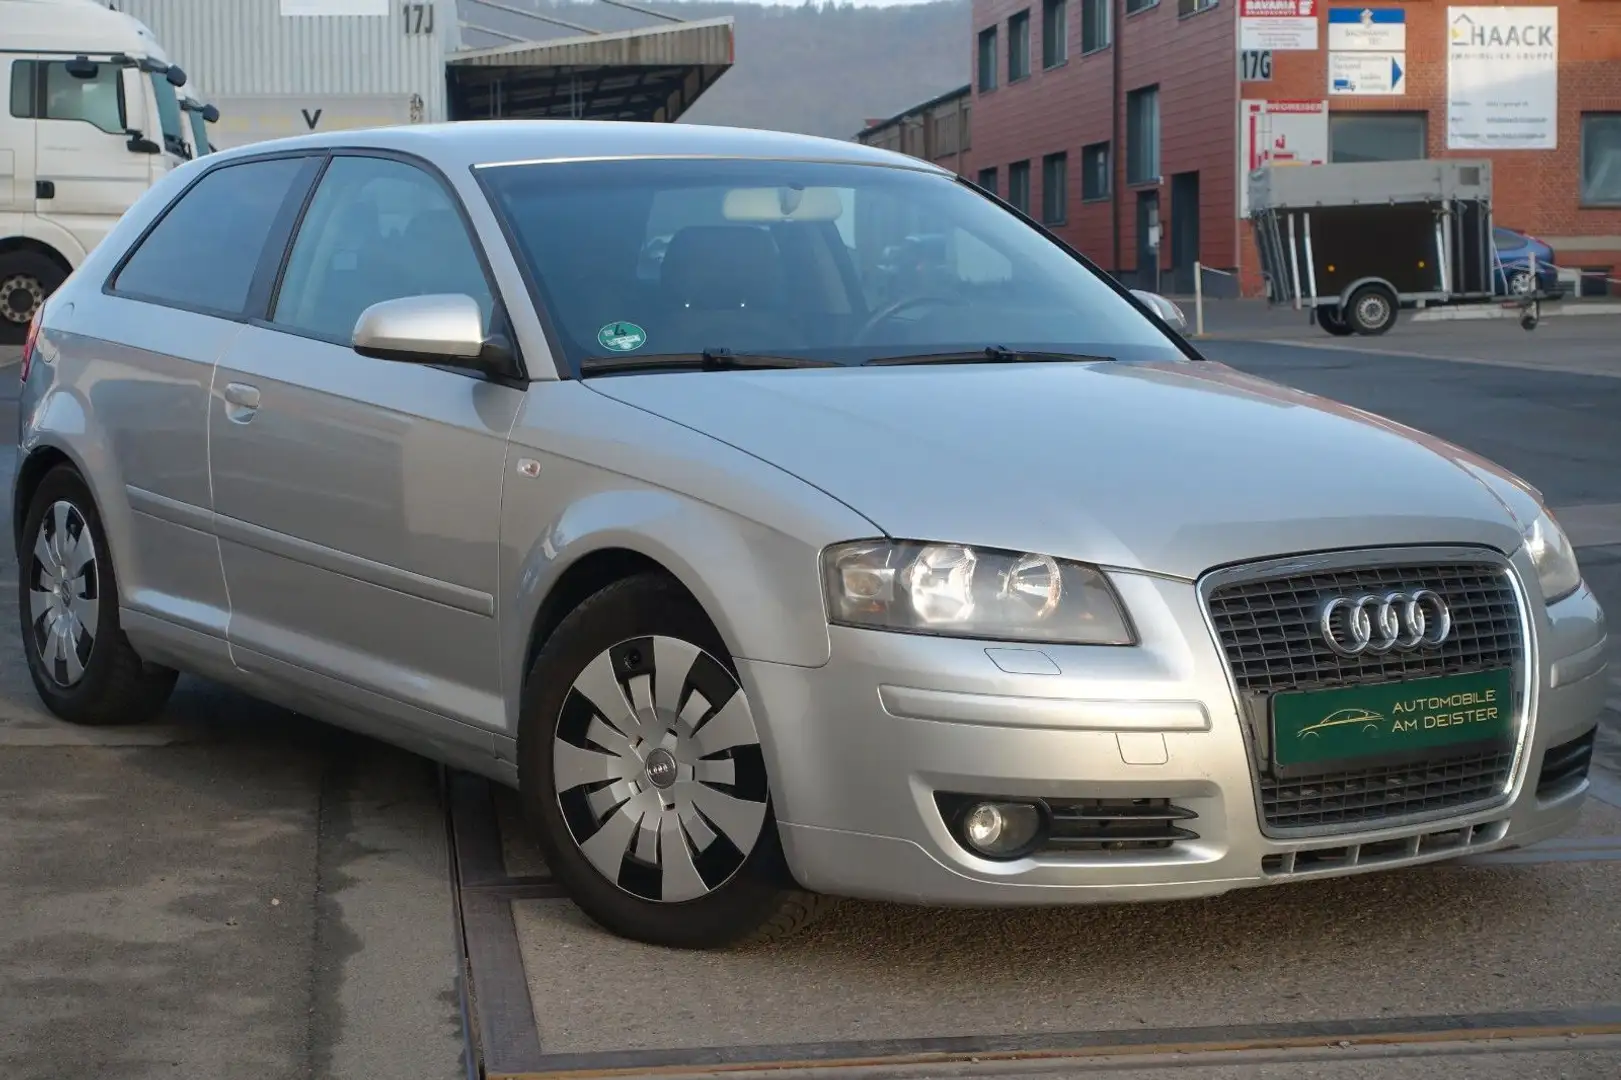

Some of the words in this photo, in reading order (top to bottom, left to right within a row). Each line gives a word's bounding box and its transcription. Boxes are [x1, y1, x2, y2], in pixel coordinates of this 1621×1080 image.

[403, 4, 434, 34] 17J
[1471, 25, 1553, 46] HAACK
[1242, 51, 1271, 79] 17G
[1392, 690, 1496, 714] AUTOMOBILE
[1392, 720, 1417, 732] AM
[1424, 707, 1498, 729] DEISTER
